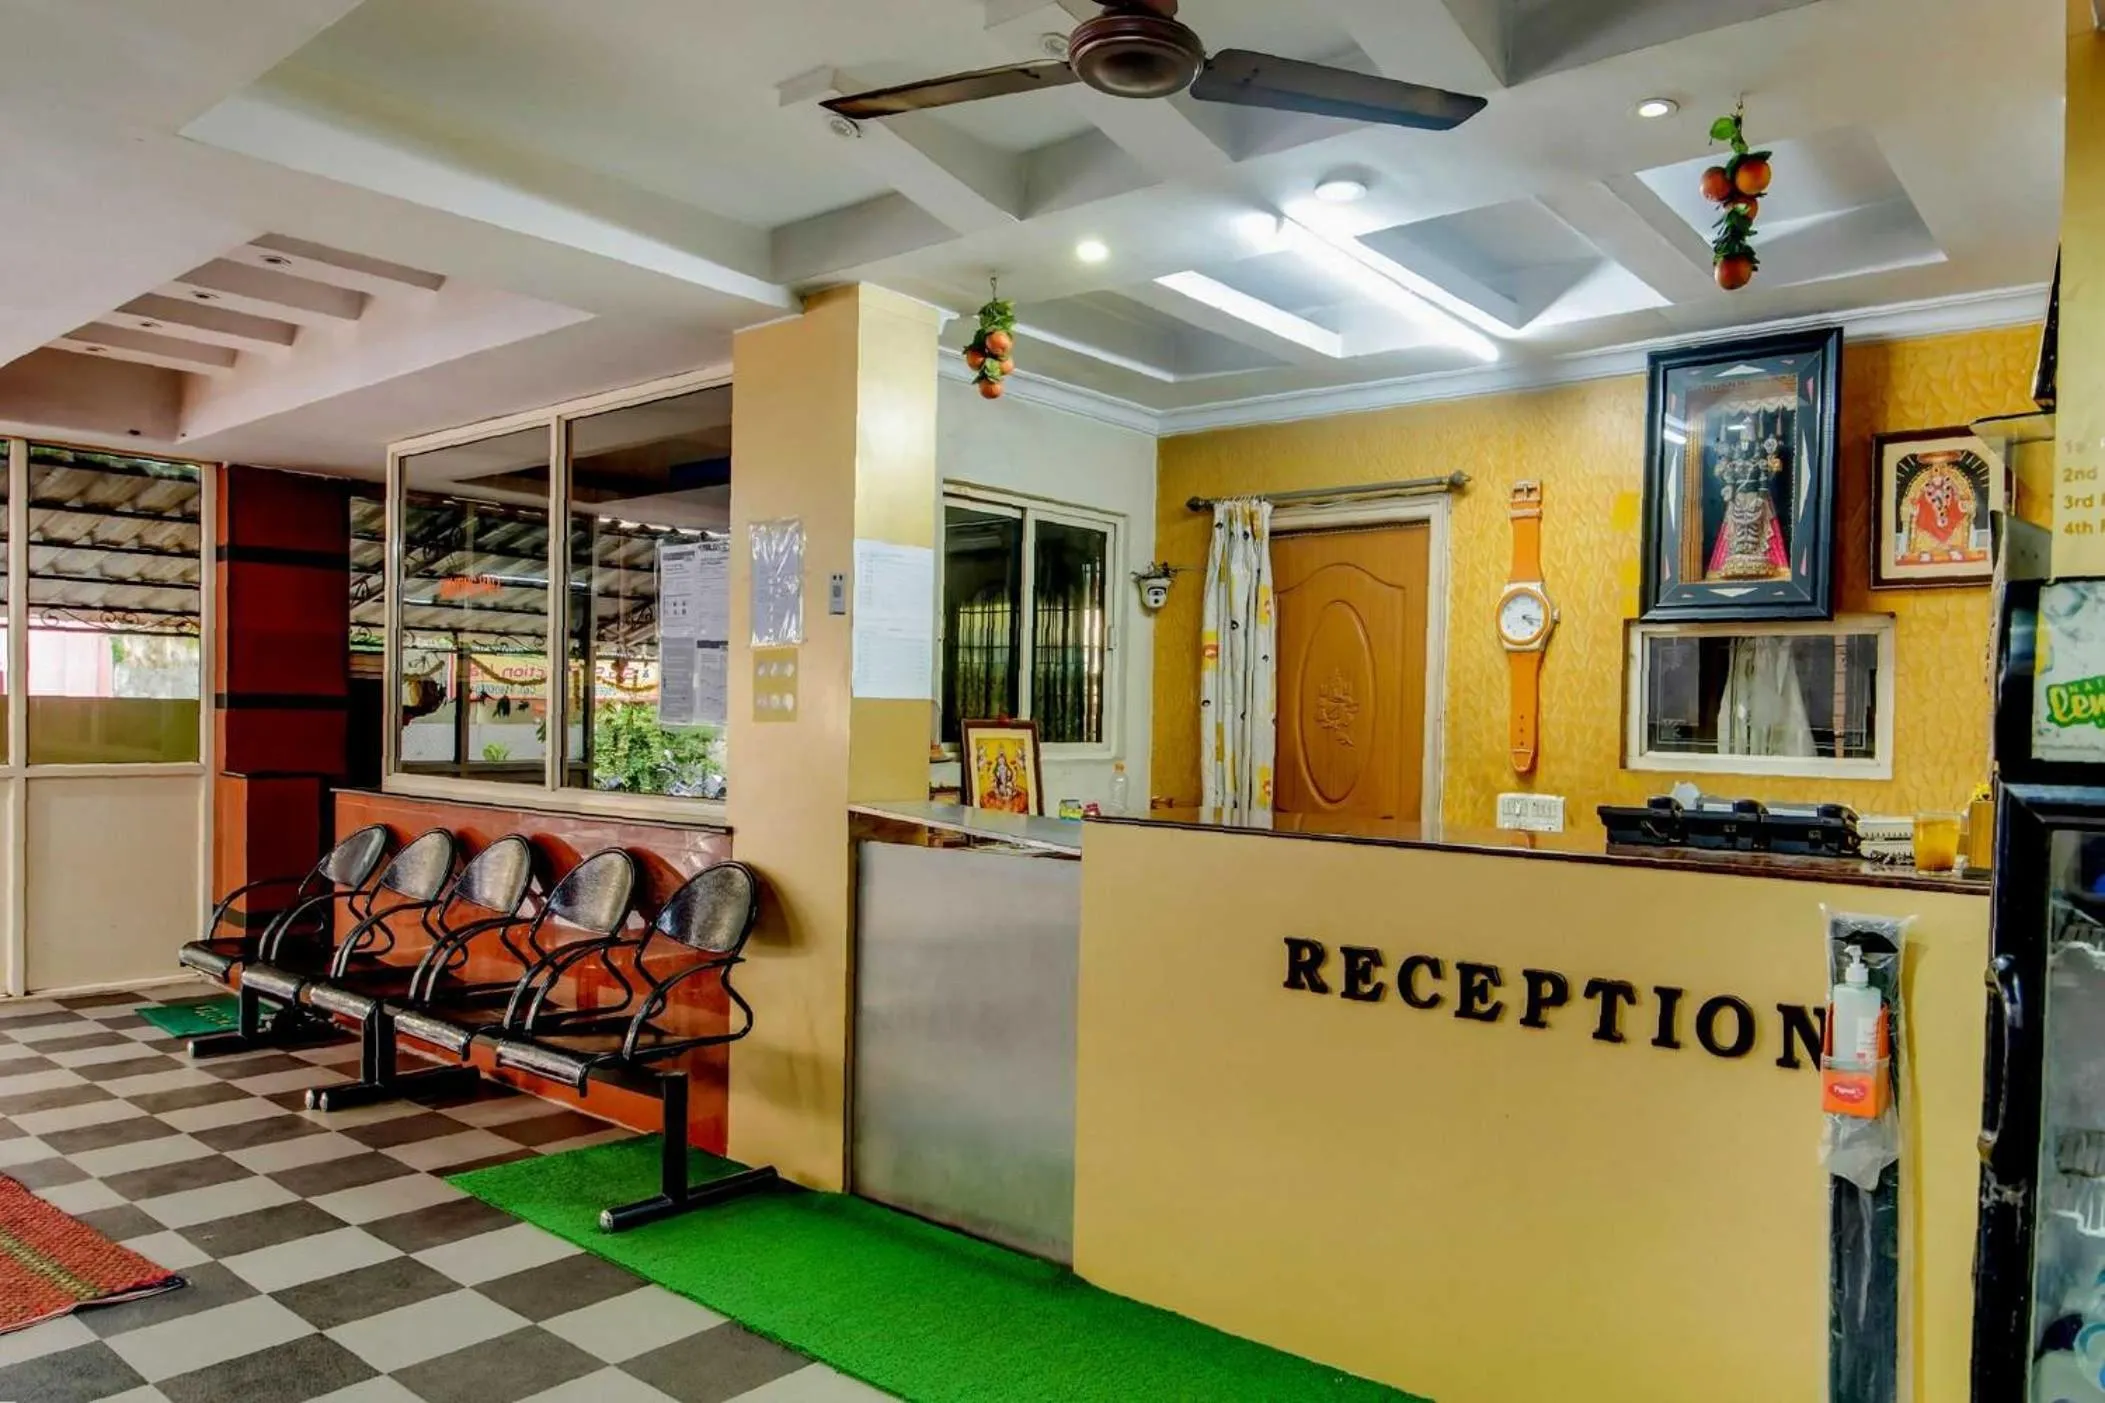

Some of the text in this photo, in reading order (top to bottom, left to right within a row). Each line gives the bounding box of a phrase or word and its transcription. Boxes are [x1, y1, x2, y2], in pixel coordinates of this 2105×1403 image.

[2063, 464, 2098, 482] 2nd
[2063, 493, 2095, 509] 3rd
[2063, 521, 2094, 536] 4th
[1283, 937, 1827, 1073] RECEPTION
